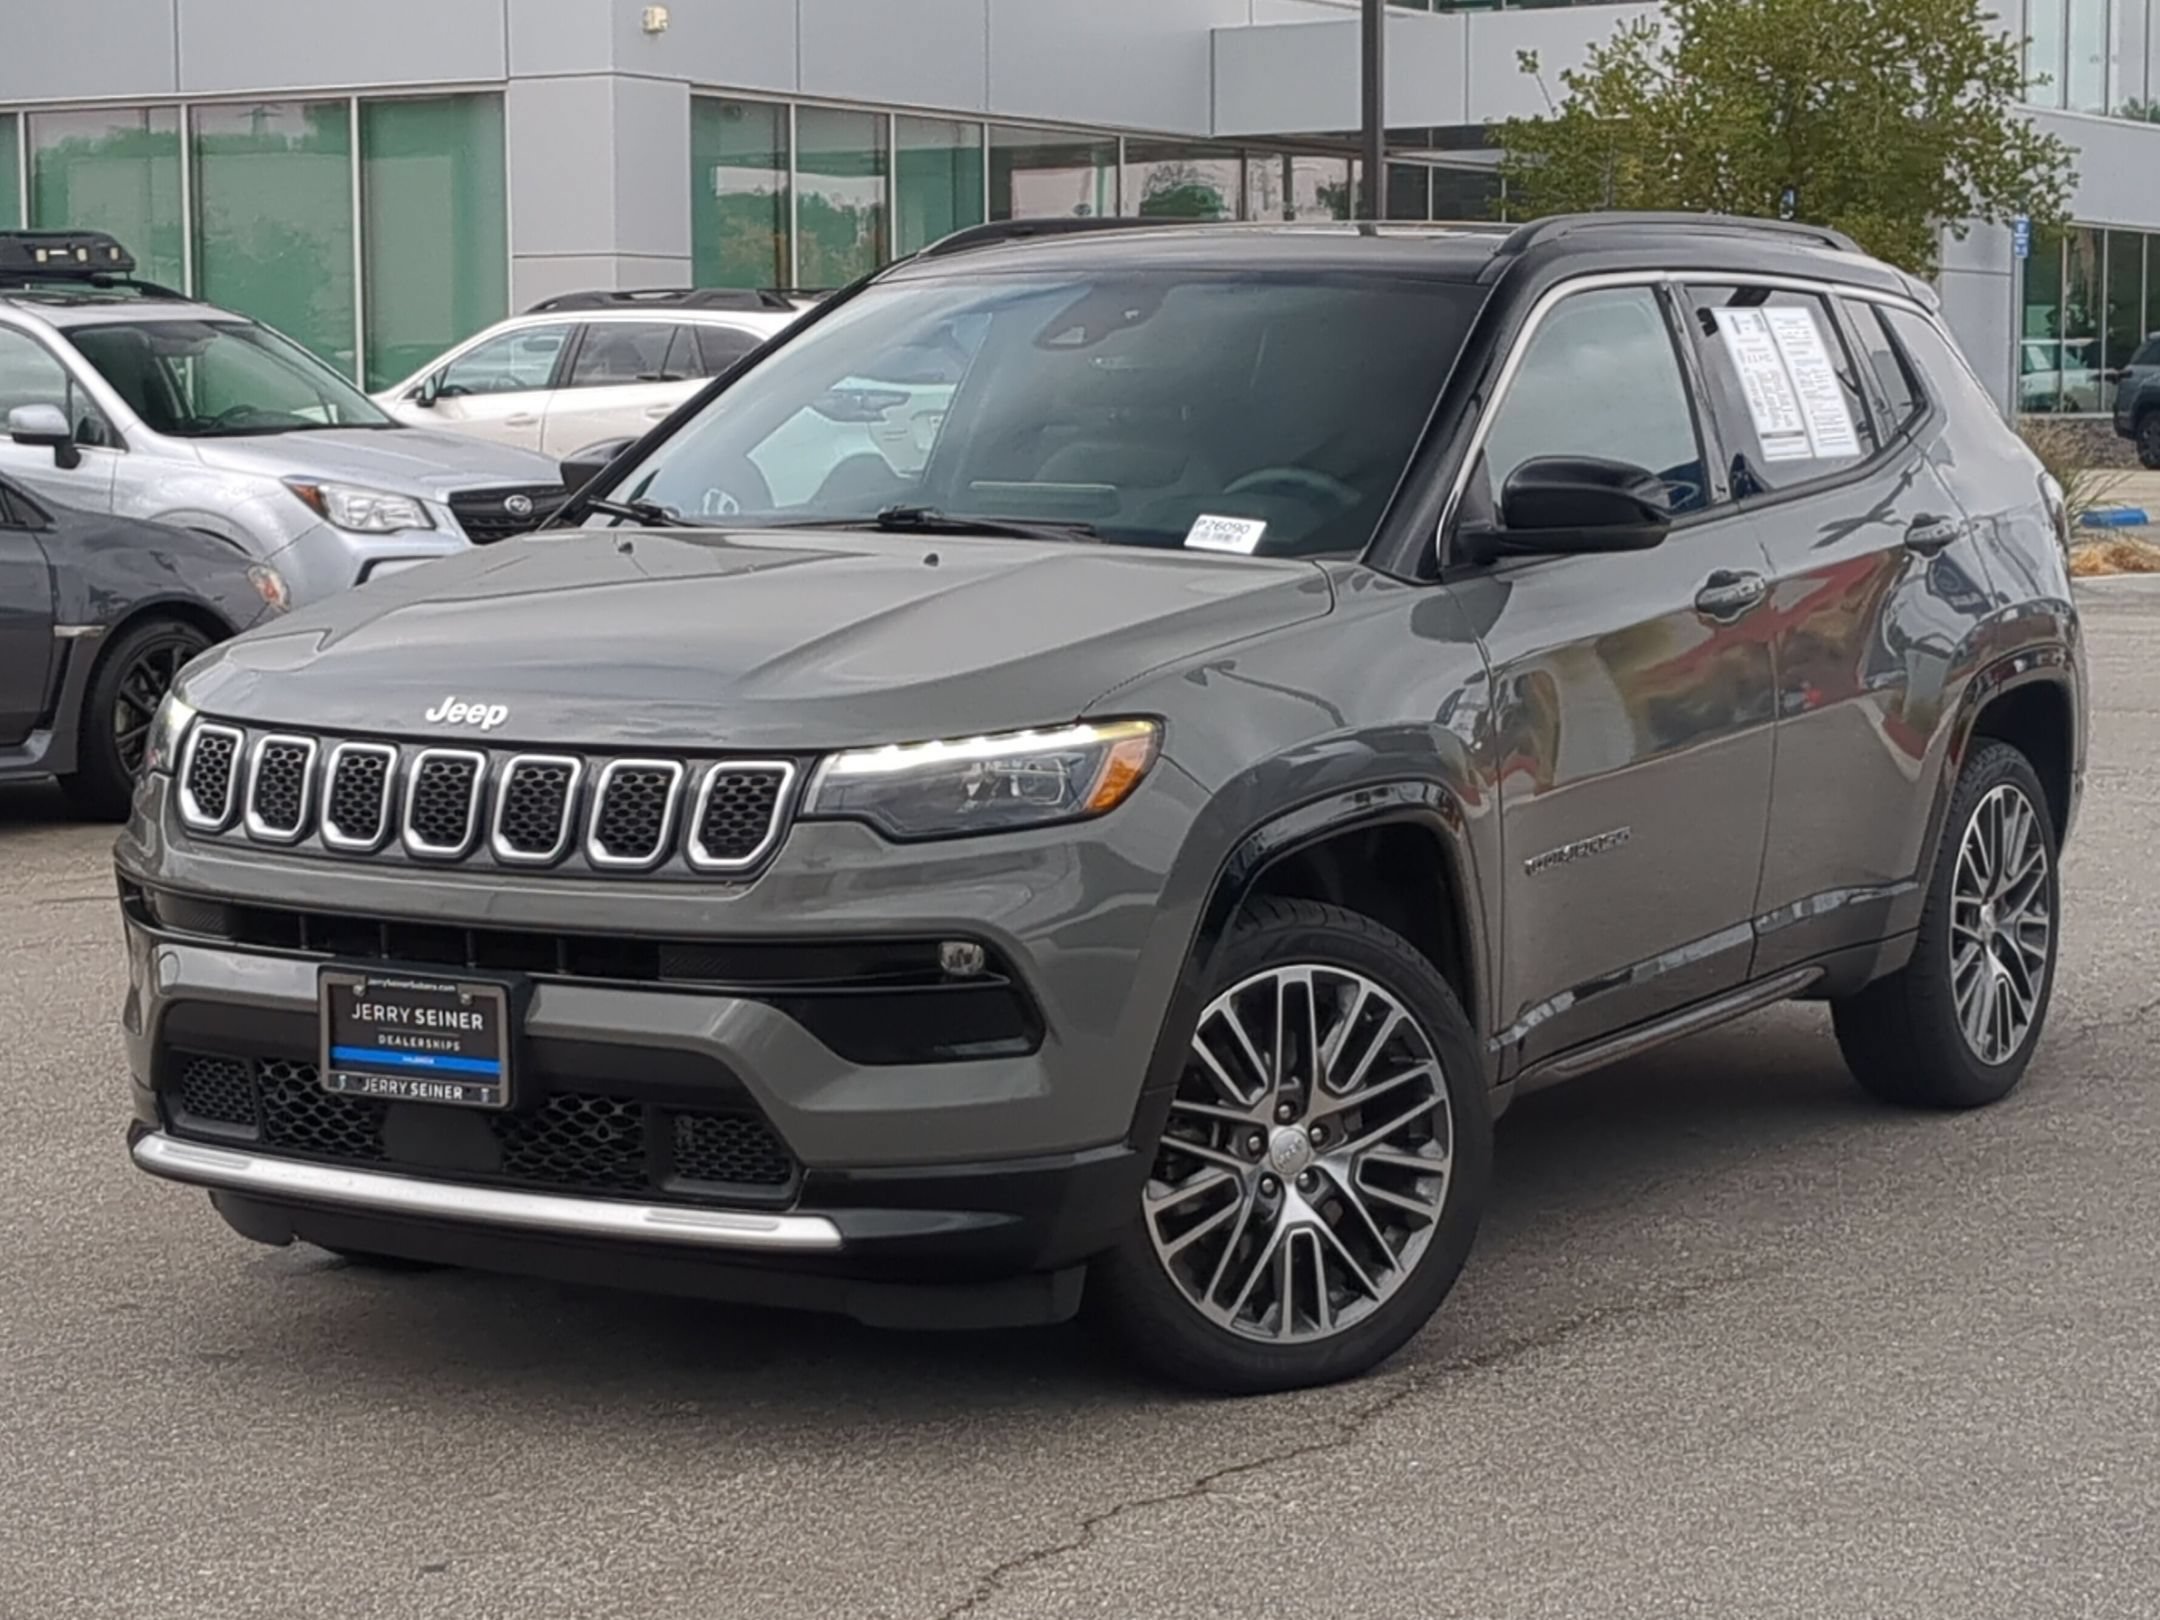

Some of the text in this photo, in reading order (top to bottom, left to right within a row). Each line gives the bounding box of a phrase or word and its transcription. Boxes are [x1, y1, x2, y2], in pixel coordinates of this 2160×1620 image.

[425, 696, 508, 730] Jeep
[352, 1003, 484, 1030] JERRY SEINER
[378, 1034, 461, 1052] DEALERSHIPS
[362, 1078, 463, 1100] JERRY SEINER
